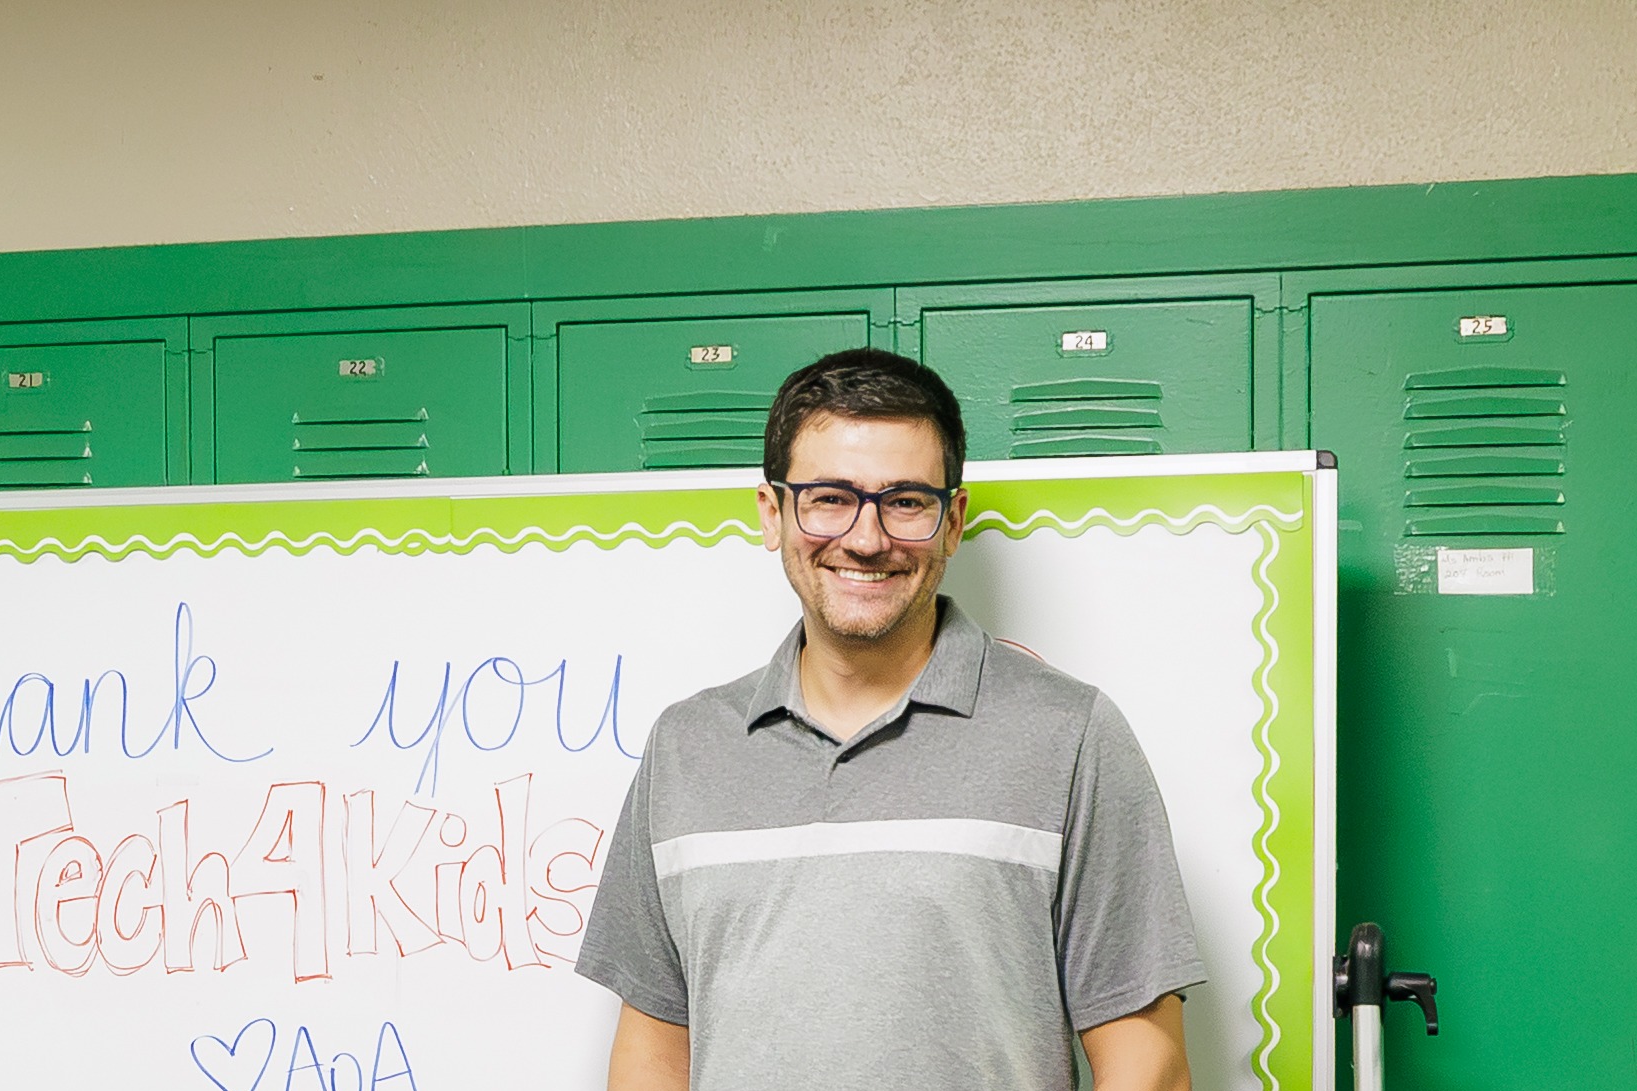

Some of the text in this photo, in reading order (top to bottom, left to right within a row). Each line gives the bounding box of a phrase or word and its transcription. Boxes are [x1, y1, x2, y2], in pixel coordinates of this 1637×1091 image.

[1472, 319, 1493, 334] 25
[1075, 335, 1094, 350] 24
[701, 347, 720, 361] 23
[349, 361, 367, 377] 22
[19, 373, 33, 387] 21
[350, 653, 644, 798] you
